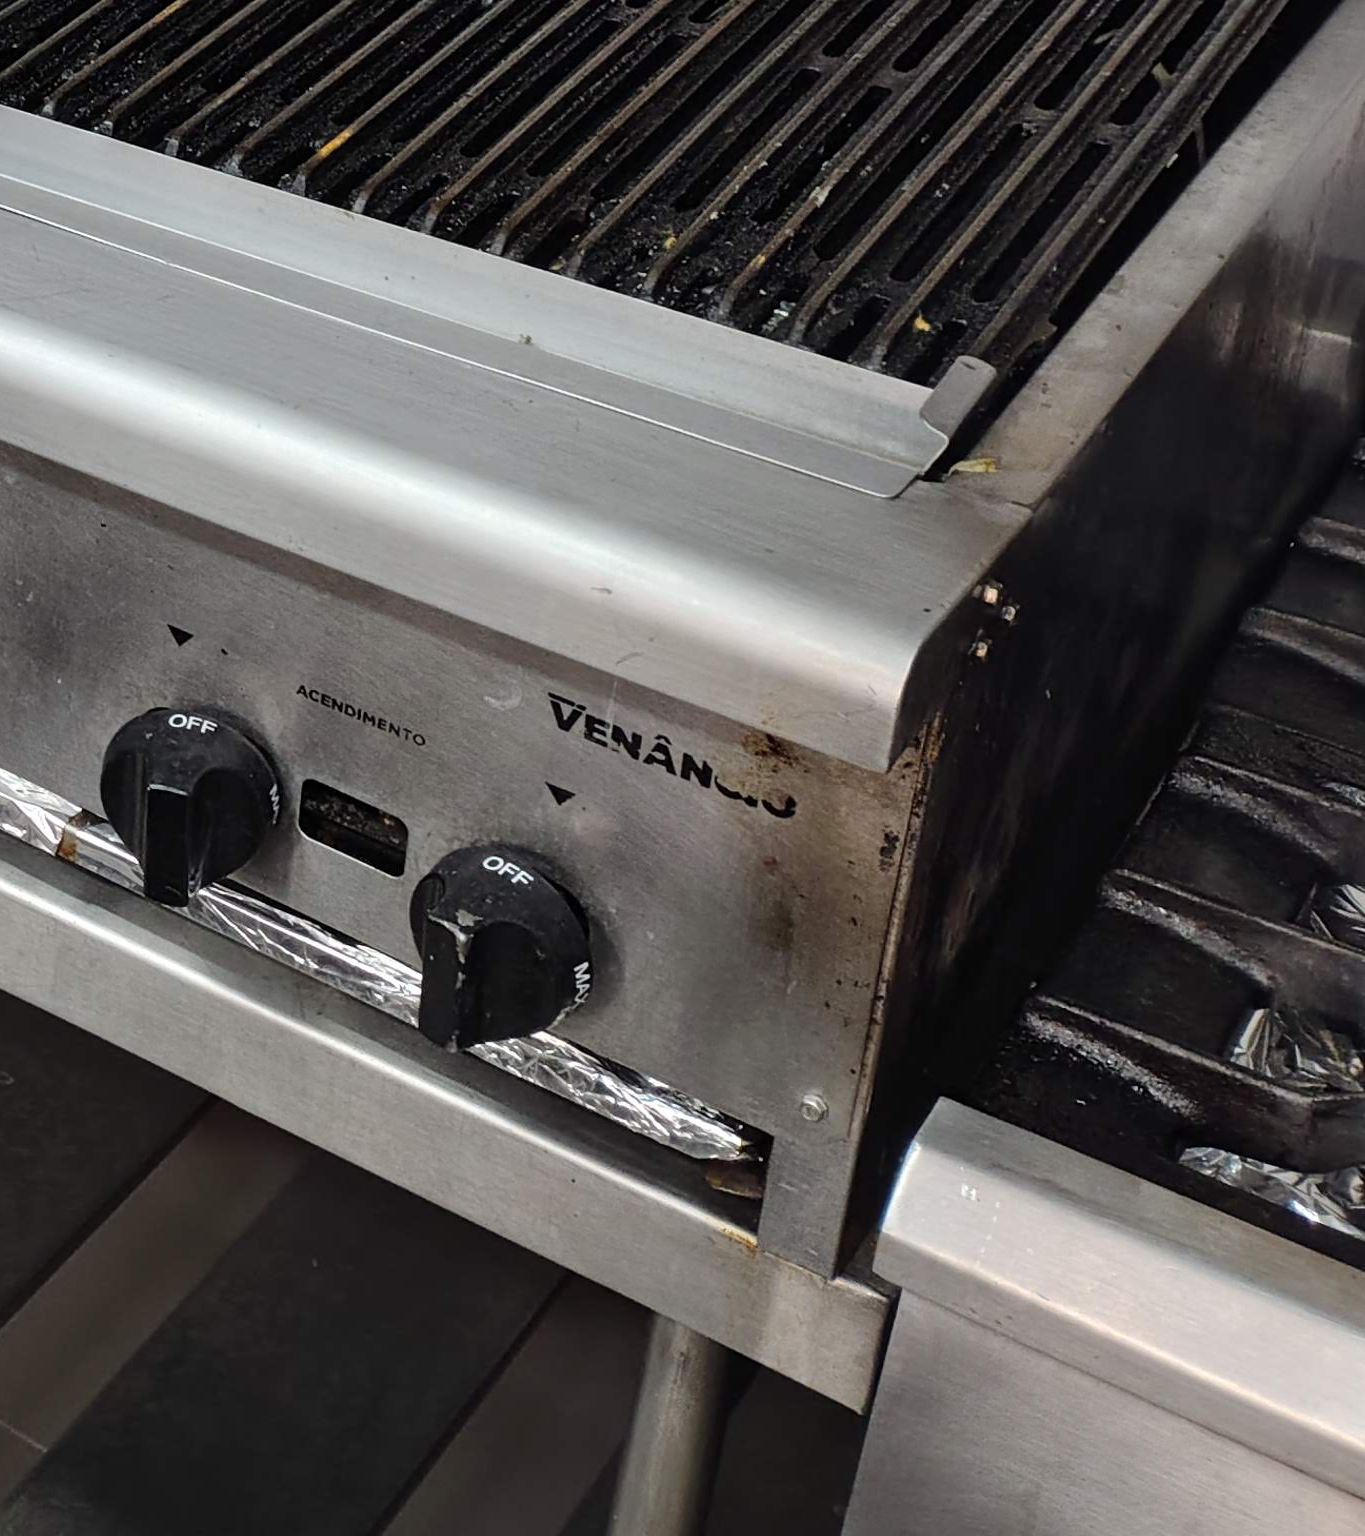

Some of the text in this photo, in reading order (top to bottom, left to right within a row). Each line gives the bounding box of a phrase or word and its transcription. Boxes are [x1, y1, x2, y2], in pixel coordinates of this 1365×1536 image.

[168, 713, 218, 735] OFF
[296, 684, 427, 747] ACENDIMENTO
[482, 855, 535, 886] OFF
[573, 961, 591, 1010] MAX
